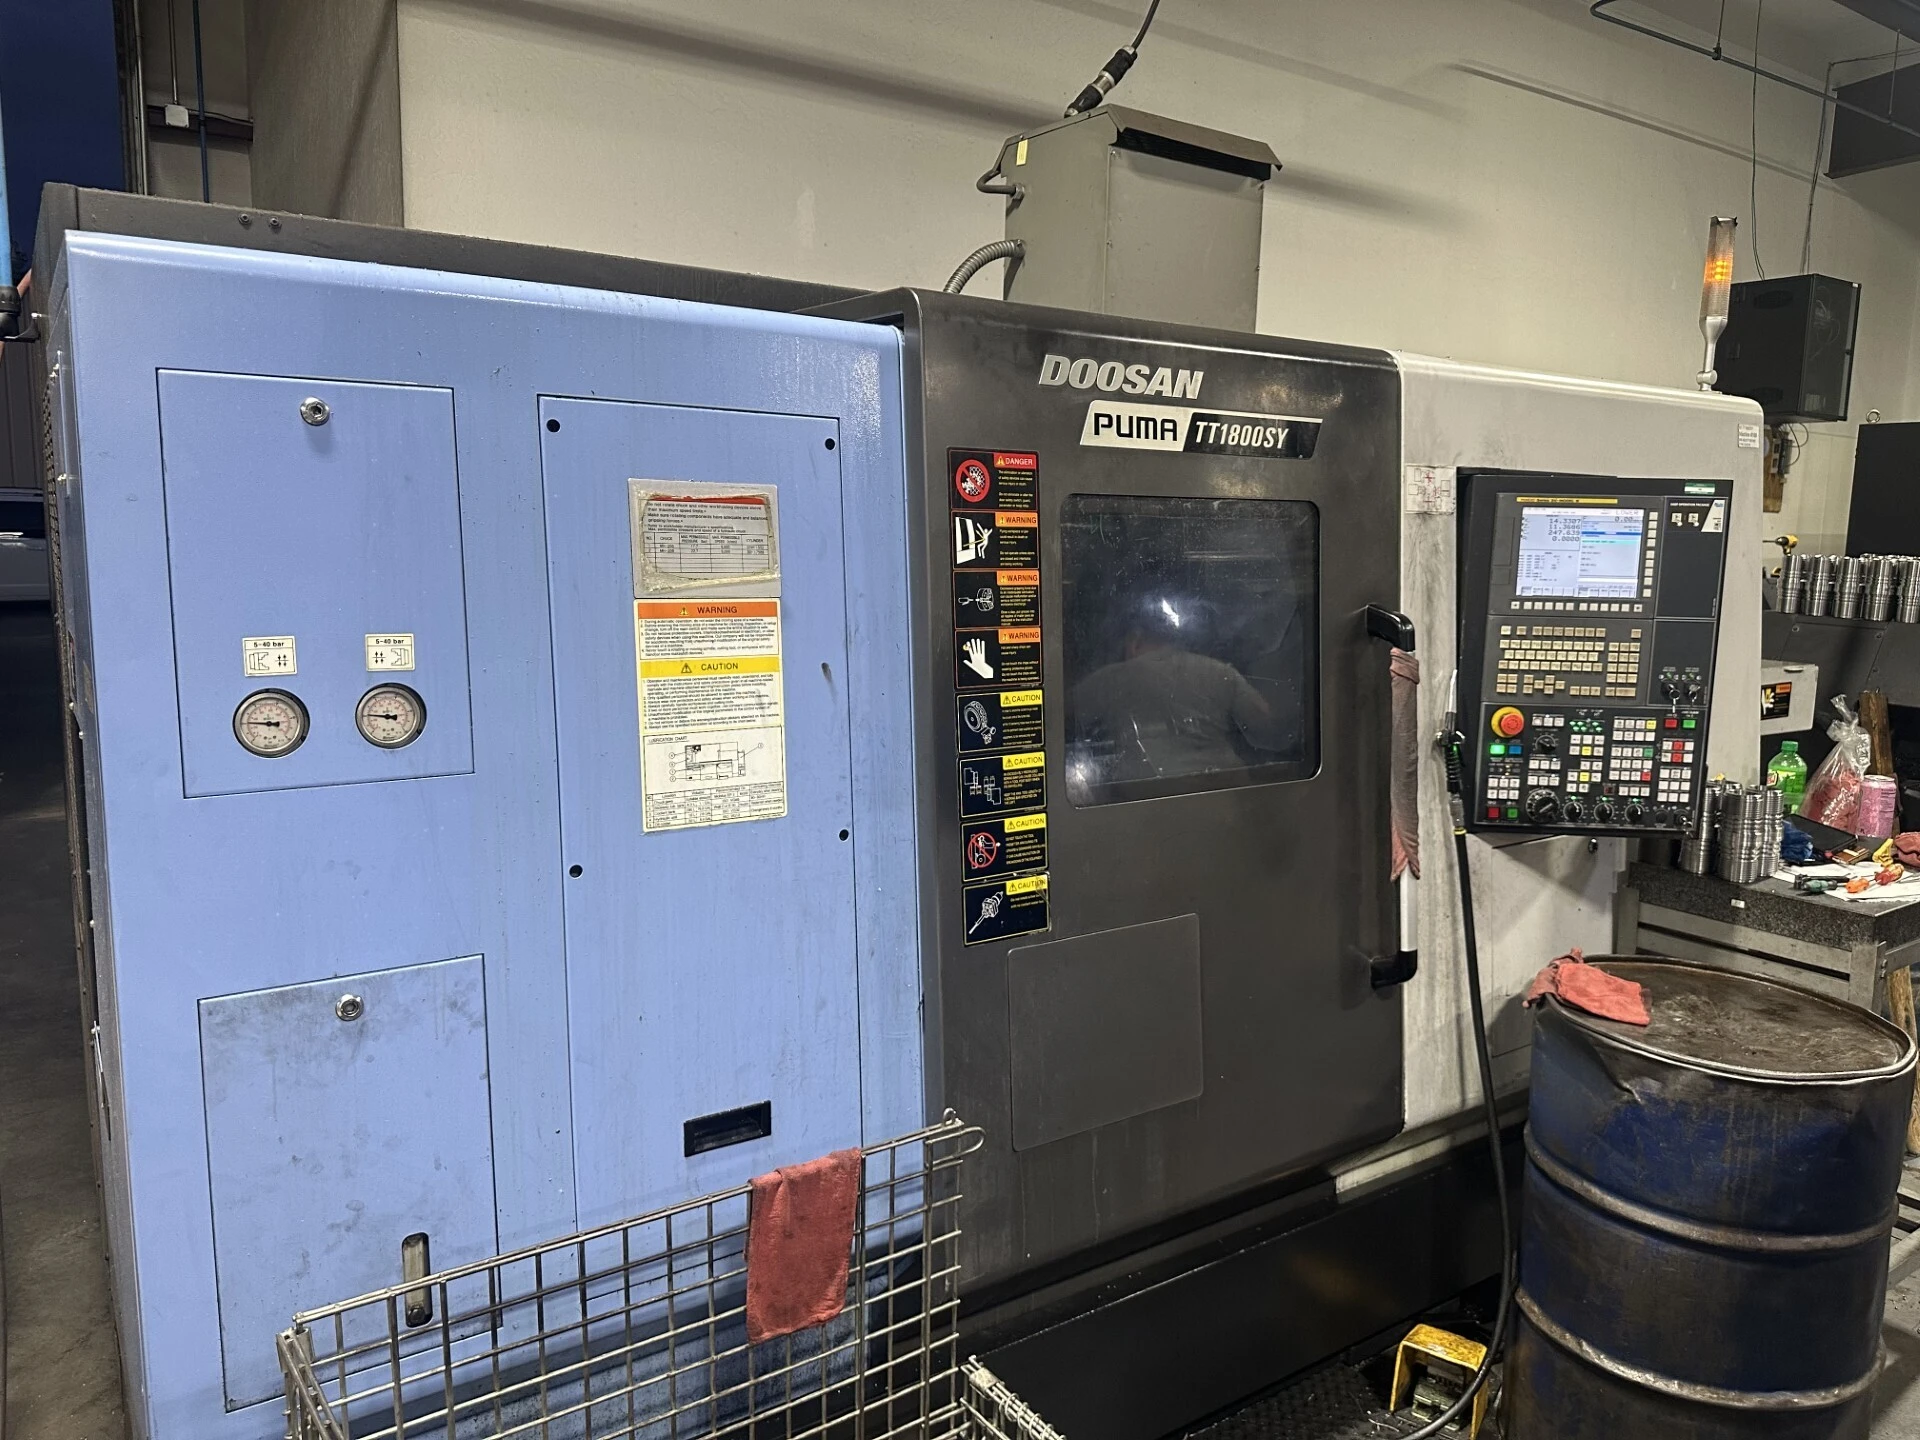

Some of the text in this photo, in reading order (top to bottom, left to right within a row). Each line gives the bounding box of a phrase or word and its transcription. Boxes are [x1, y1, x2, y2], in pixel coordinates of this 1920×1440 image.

[1039, 354, 1204, 399] DOOSAN
[1093, 412, 1290, 449] PUMA TT1800SY
[1005, 457, 1033, 466] DANGER
[1006, 516, 1037, 524] WARNING
[1007, 574, 1038, 582] WARNING
[697, 606, 738, 615] WARNING
[1009, 631, 1040, 639] WARNING
[701, 662, 739, 671] CAUTION
[1011, 694, 1041, 703] CAUTION
[1014, 757, 1043, 766] CAUTION
[1016, 818, 1045, 827] CAUTION
[1017, 879, 1047, 890] CAUTION
